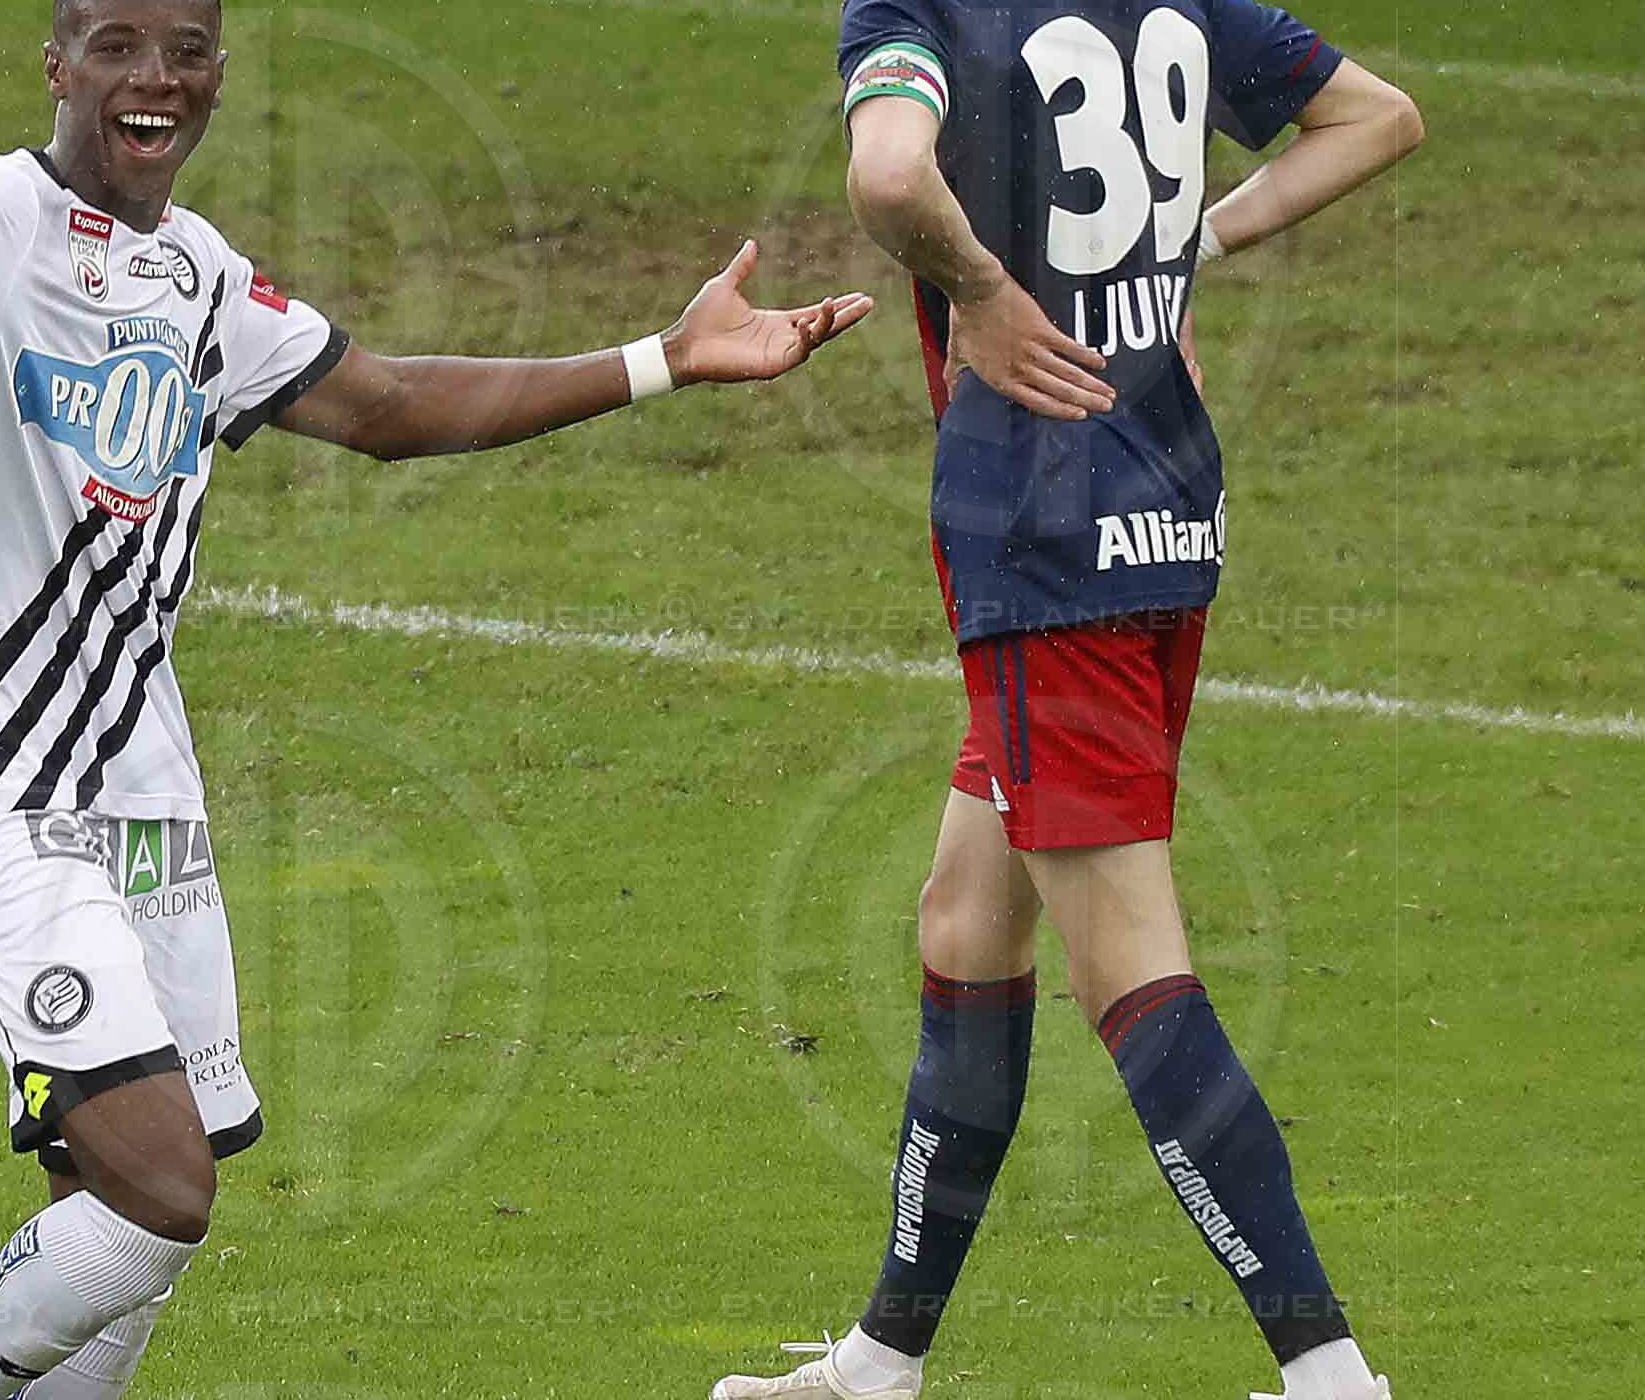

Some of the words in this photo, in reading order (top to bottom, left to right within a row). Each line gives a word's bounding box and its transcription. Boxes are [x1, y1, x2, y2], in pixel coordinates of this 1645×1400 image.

[1019, 5, 1210, 277] 39
[73, 211, 110, 234] tipico
[1095, 509, 1217, 572] Allian
[132, 882, 220, 924] HOLDING
[893, 1118, 942, 1265] RAPIDSHOP.AT
[1154, 1137, 1265, 1281] RAPIDSHOP.AT
